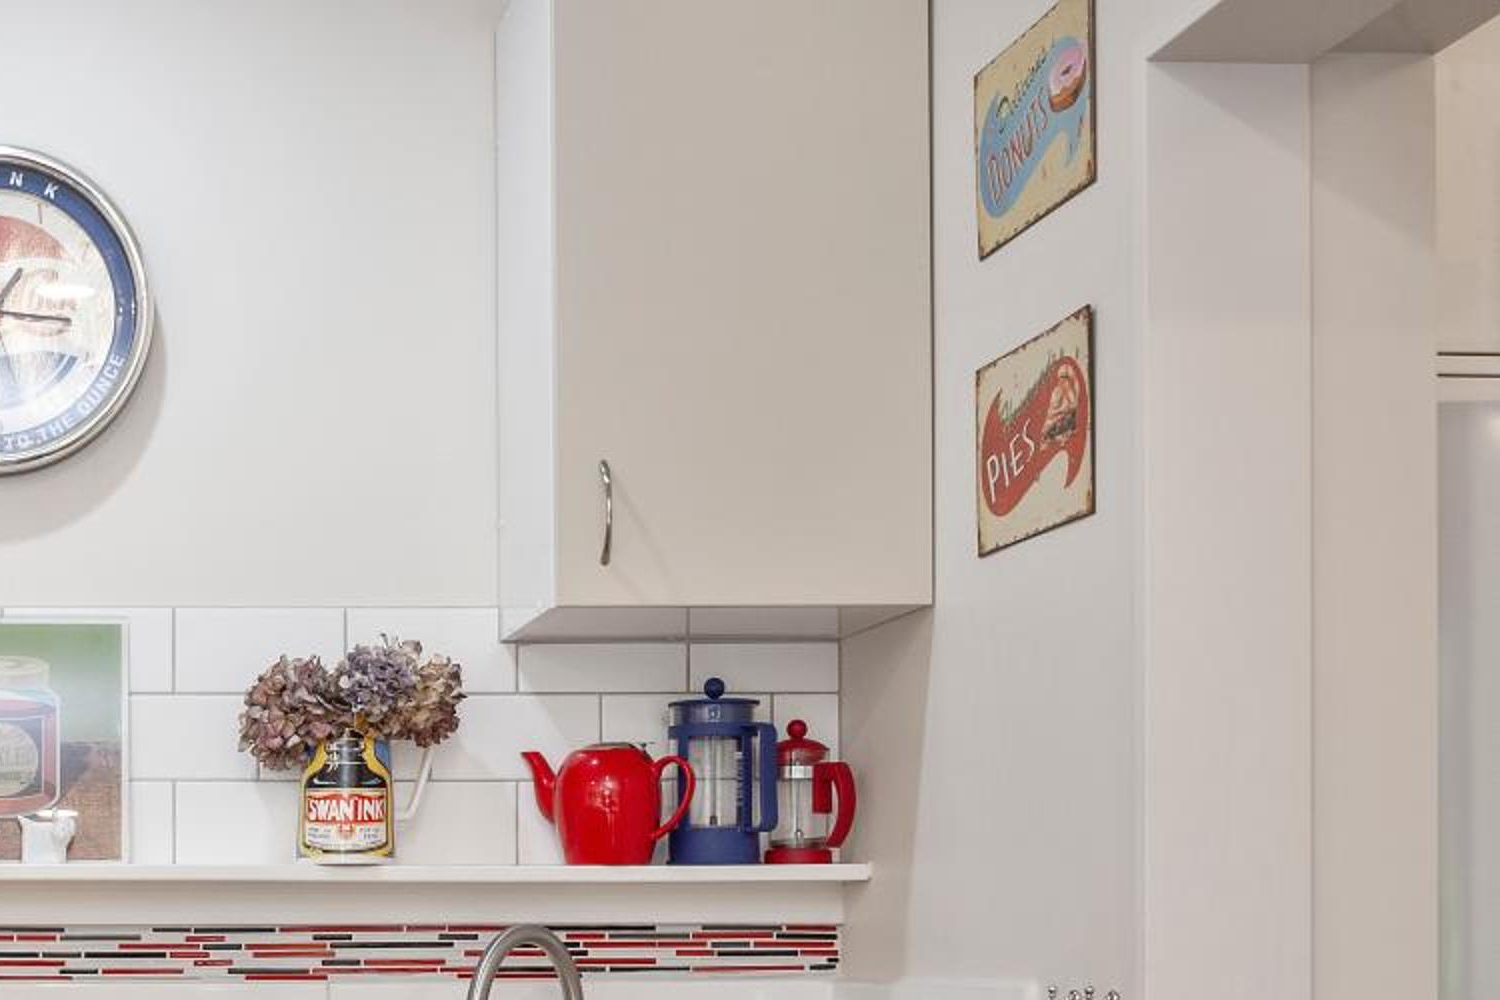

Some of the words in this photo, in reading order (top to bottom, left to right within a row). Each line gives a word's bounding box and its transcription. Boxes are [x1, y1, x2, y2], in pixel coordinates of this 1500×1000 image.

[987, 95, 1049, 204] DONUTS
[34, 412, 76, 443] THE
[78, 353, 127, 418] OUNCE
[986, 418, 1036, 505] PIES
[309, 798, 354, 821] SWAN
[357, 798, 384, 821] INK
